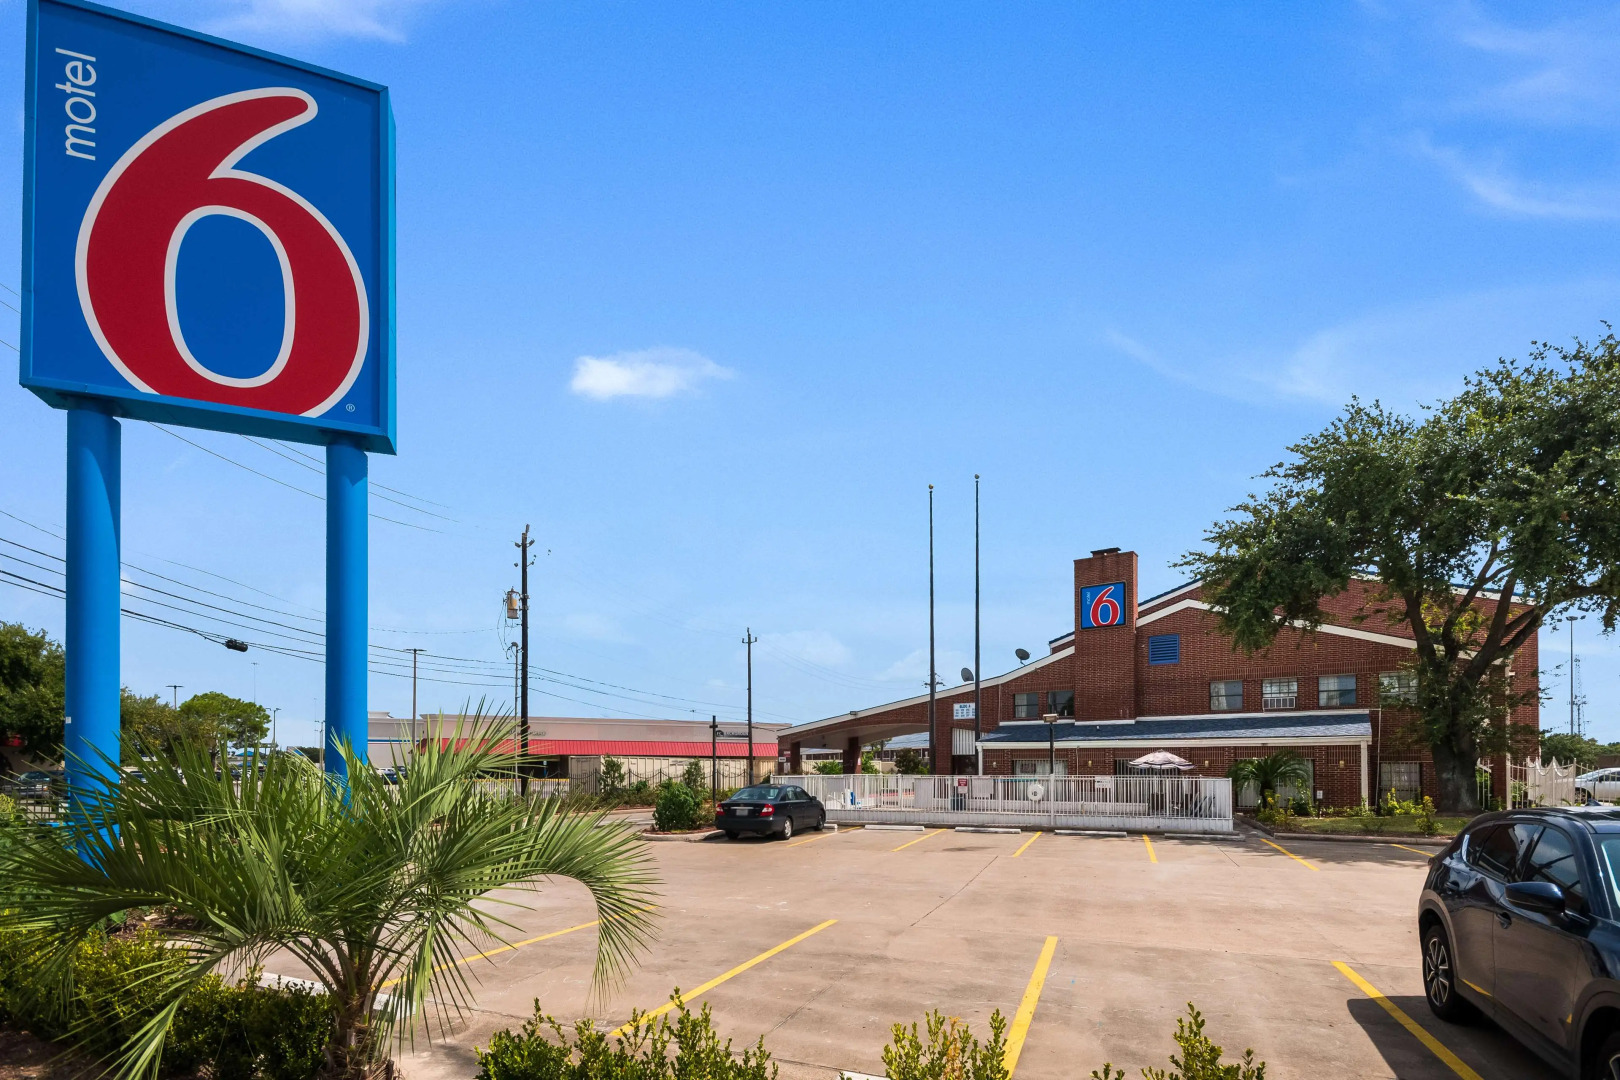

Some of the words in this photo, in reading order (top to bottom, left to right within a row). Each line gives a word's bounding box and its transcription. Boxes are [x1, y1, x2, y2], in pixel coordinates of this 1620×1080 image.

[55, 47, 97, 161] motel
[75, 86, 370, 419] 6
[1090, 585, 1121, 627] 6
